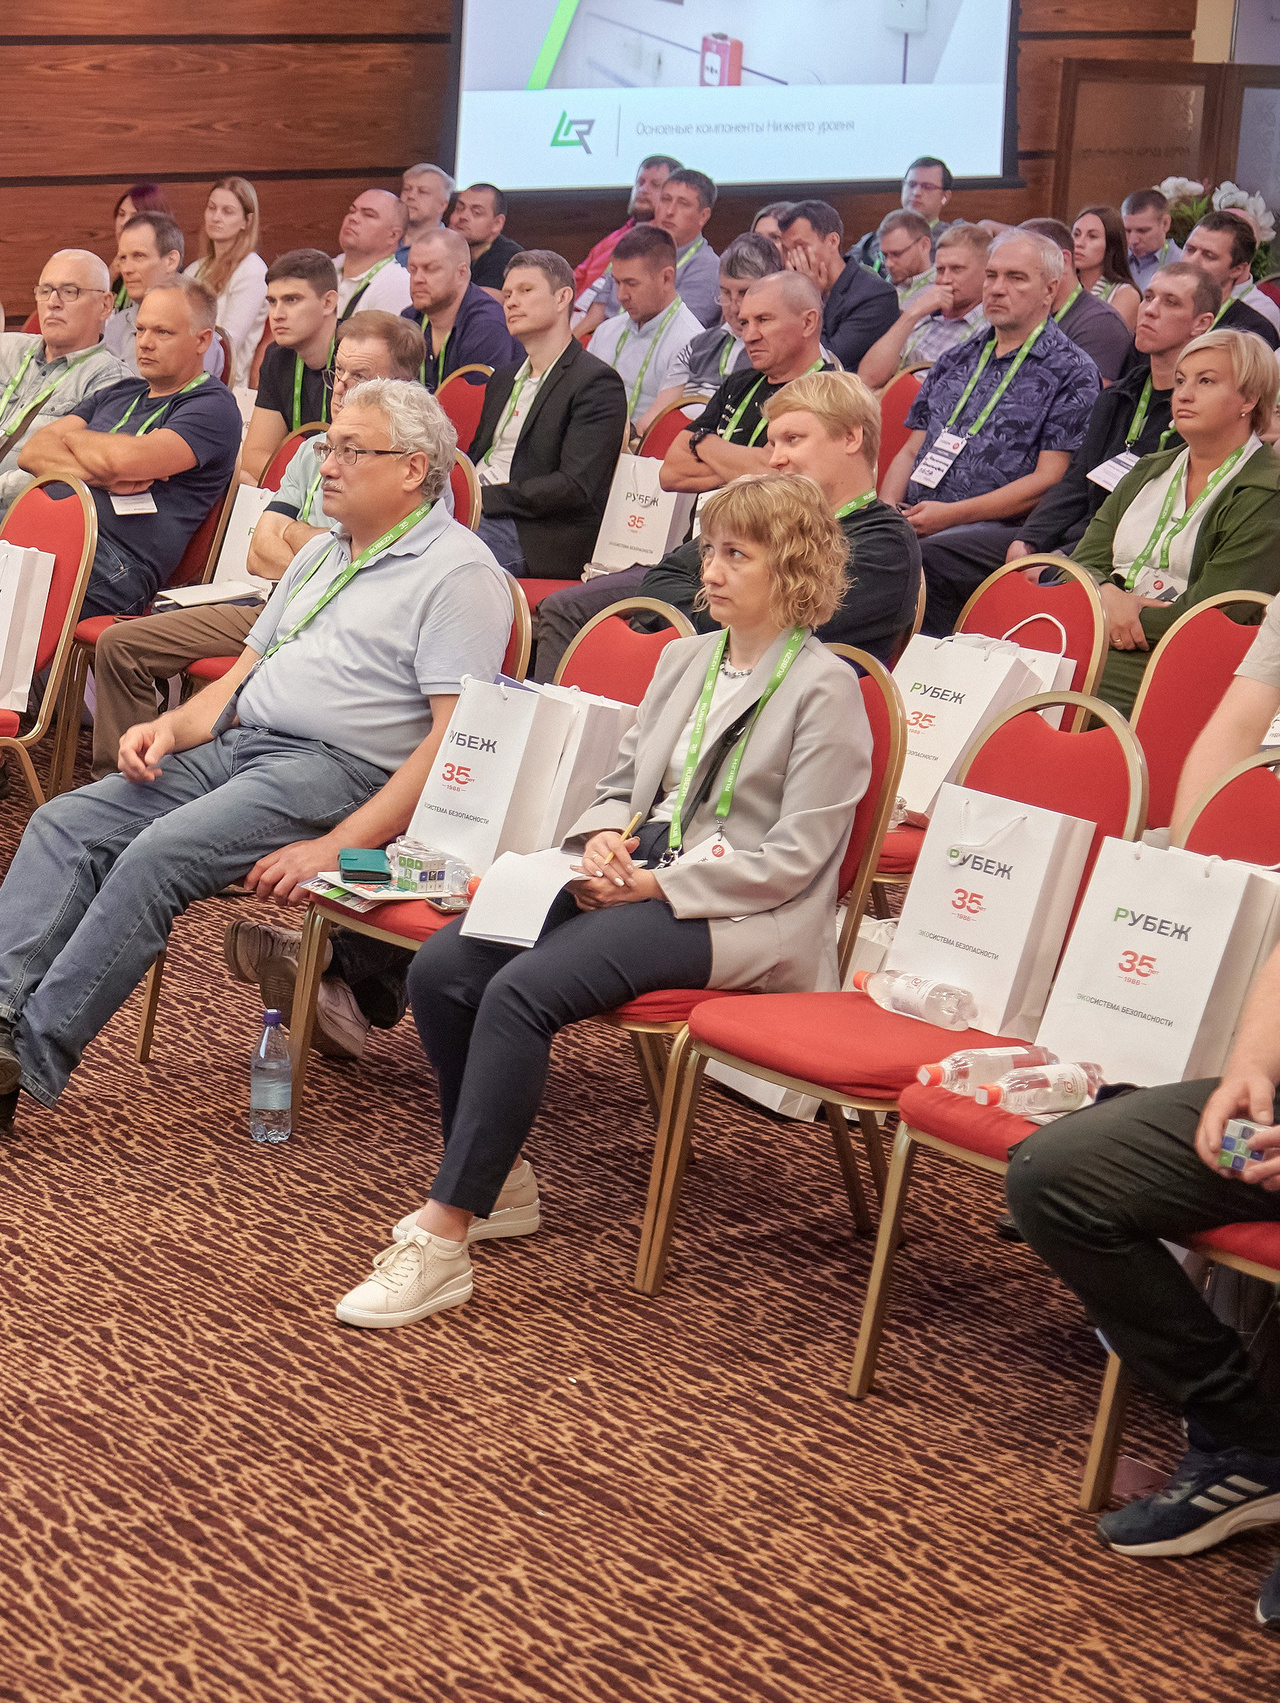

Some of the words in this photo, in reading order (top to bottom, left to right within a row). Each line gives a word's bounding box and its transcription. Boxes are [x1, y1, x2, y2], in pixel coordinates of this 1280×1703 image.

[636, 122, 694, 135] Основные
[696, 123, 765, 134] компоненты
[767, 119, 815, 132] Нижнего
[818, 120, 855, 135] уровня
[627, 514, 645, 529] 35
[368, 533, 394, 555] RUBEZH
[776, 648, 794, 679] RUBEZH
[910, 682, 966, 705] РУБЕЖ
[695, 702, 708, 734] RUBEZH
[906, 710, 936, 729] 35
[449, 730, 498, 754] УБЕЖ
[441, 762, 472, 785] 35
[681, 766, 694, 797] RUBEZH
[725, 758, 738, 792] RUBEZH
[448, 809, 490, 825] БЕЗОПАСНОСТИ
[951, 888, 984, 914] 35
[1113, 906, 1192, 942] РУБЕЖ
[918, 929, 955, 946] ЭКОСИСТЕМА
[955, 941, 999, 961] БЕЗОПАСНОСТИ
[1118, 950, 1158, 978] 35
[1124, 976, 1141, 986] 1988
[1076, 992, 1120, 1012] ЭКОСИСТЕМА
[1121, 1006, 1174, 1027] БЕЗОПАСНОСТИ
